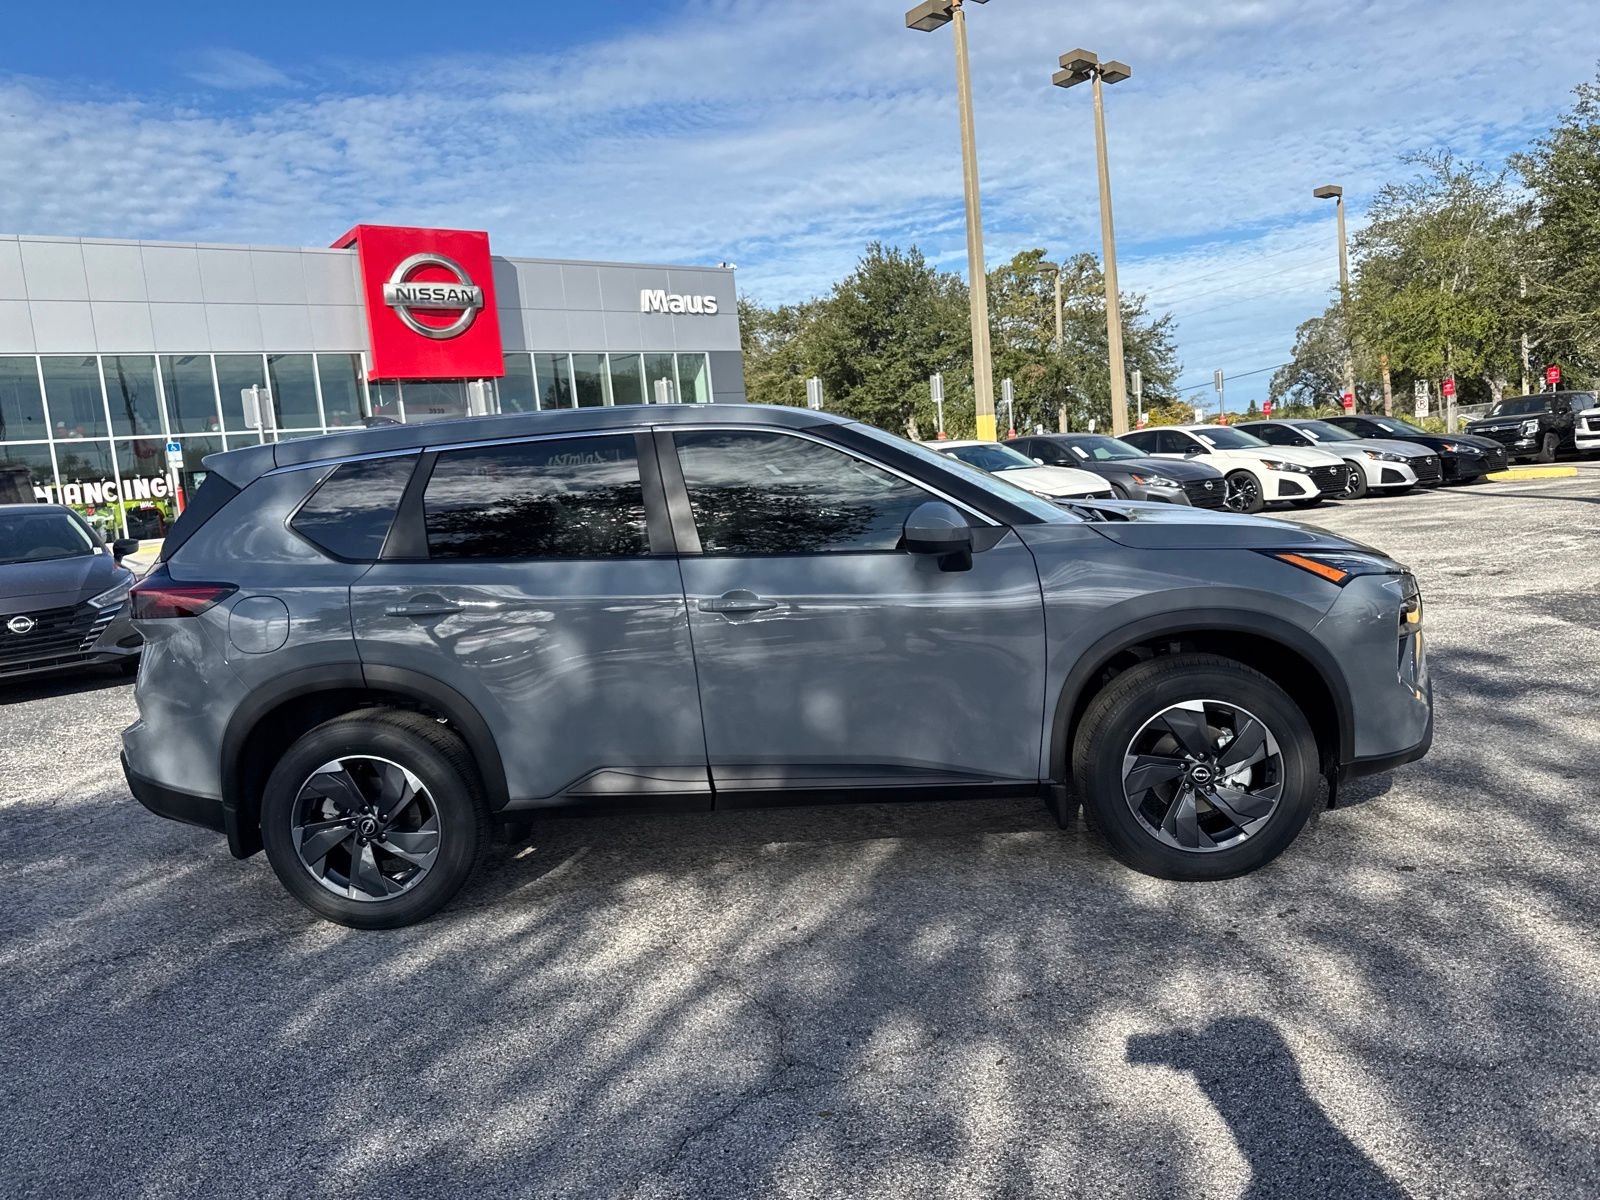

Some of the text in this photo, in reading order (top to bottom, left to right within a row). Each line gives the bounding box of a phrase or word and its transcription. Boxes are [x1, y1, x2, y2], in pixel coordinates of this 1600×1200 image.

[395, 287, 475, 303] NISSAN
[640, 289, 718, 314] Maus
[33, 473, 174, 505] NANCING!
